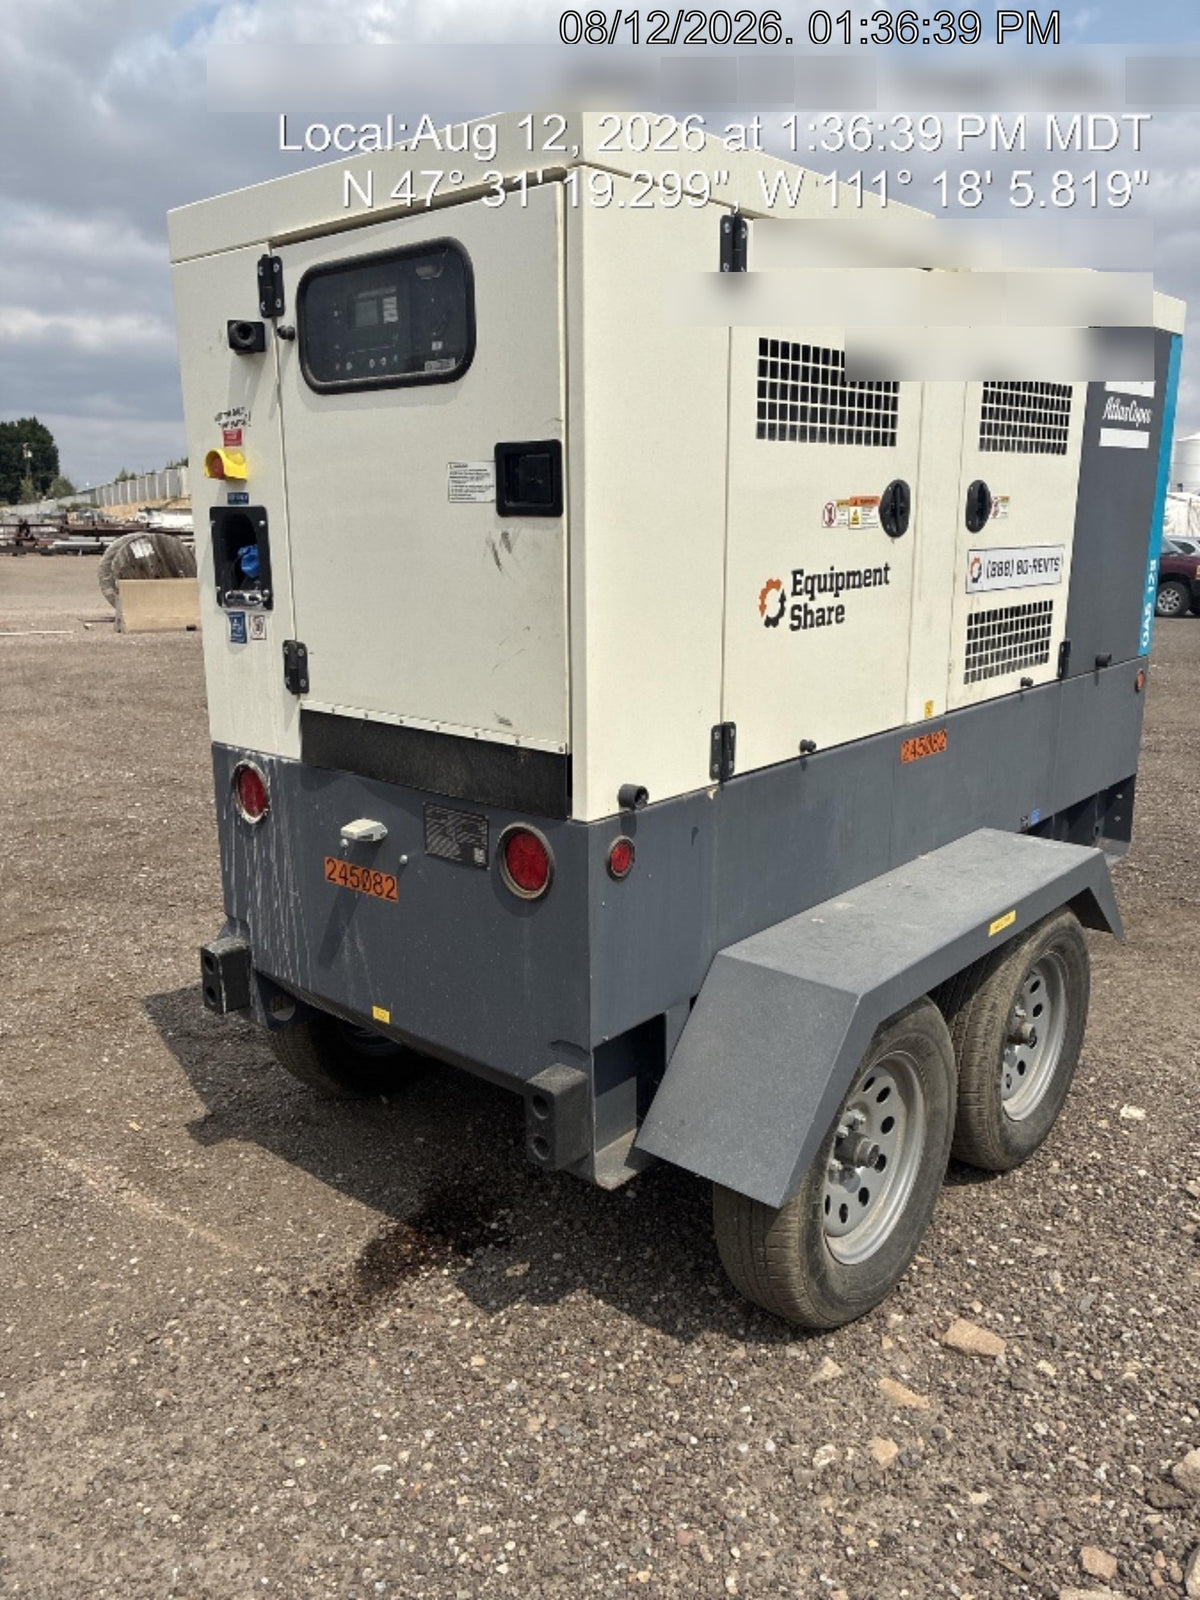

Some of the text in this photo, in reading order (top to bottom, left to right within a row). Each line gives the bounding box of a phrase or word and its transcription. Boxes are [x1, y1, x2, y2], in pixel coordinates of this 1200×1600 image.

[791, 561, 891, 601] Equipment
[789, 602, 845, 632] Share
[903, 730, 947, 762] 245082
[325, 859, 397, 900] 245082
